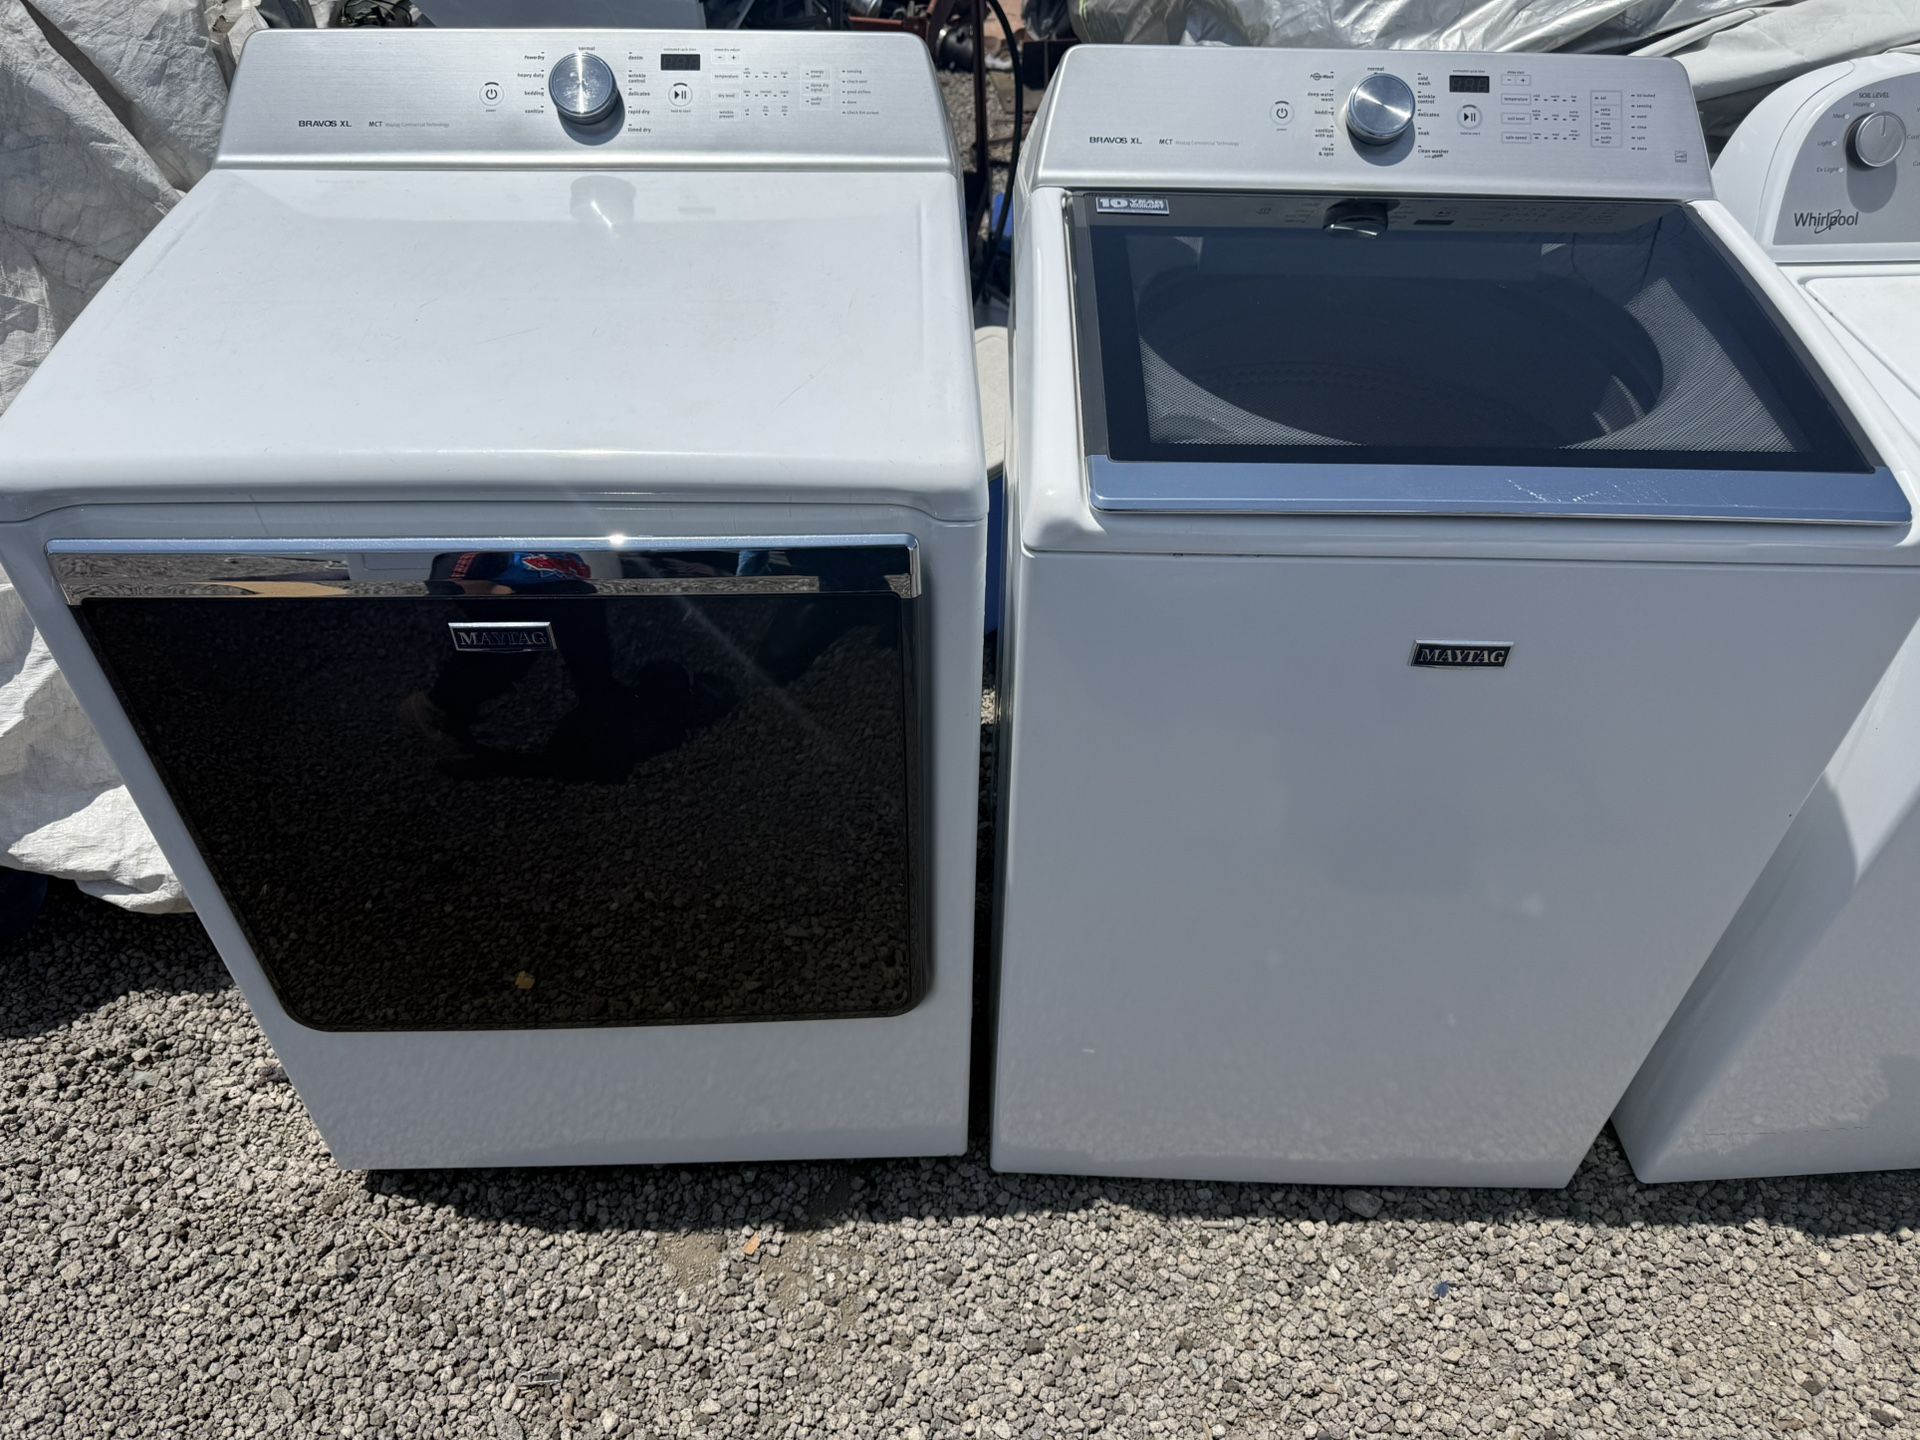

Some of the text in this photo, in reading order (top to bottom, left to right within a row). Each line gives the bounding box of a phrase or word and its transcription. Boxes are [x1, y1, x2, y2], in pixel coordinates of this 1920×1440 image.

[1089, 136, 1128, 144] BRAVOS
[1100, 198, 1129, 208] 10
[1794, 211, 1859, 231] Whirlpool
[457, 631, 547, 646] MAYTAG
[1420, 648, 1505, 663] MAYTAG
